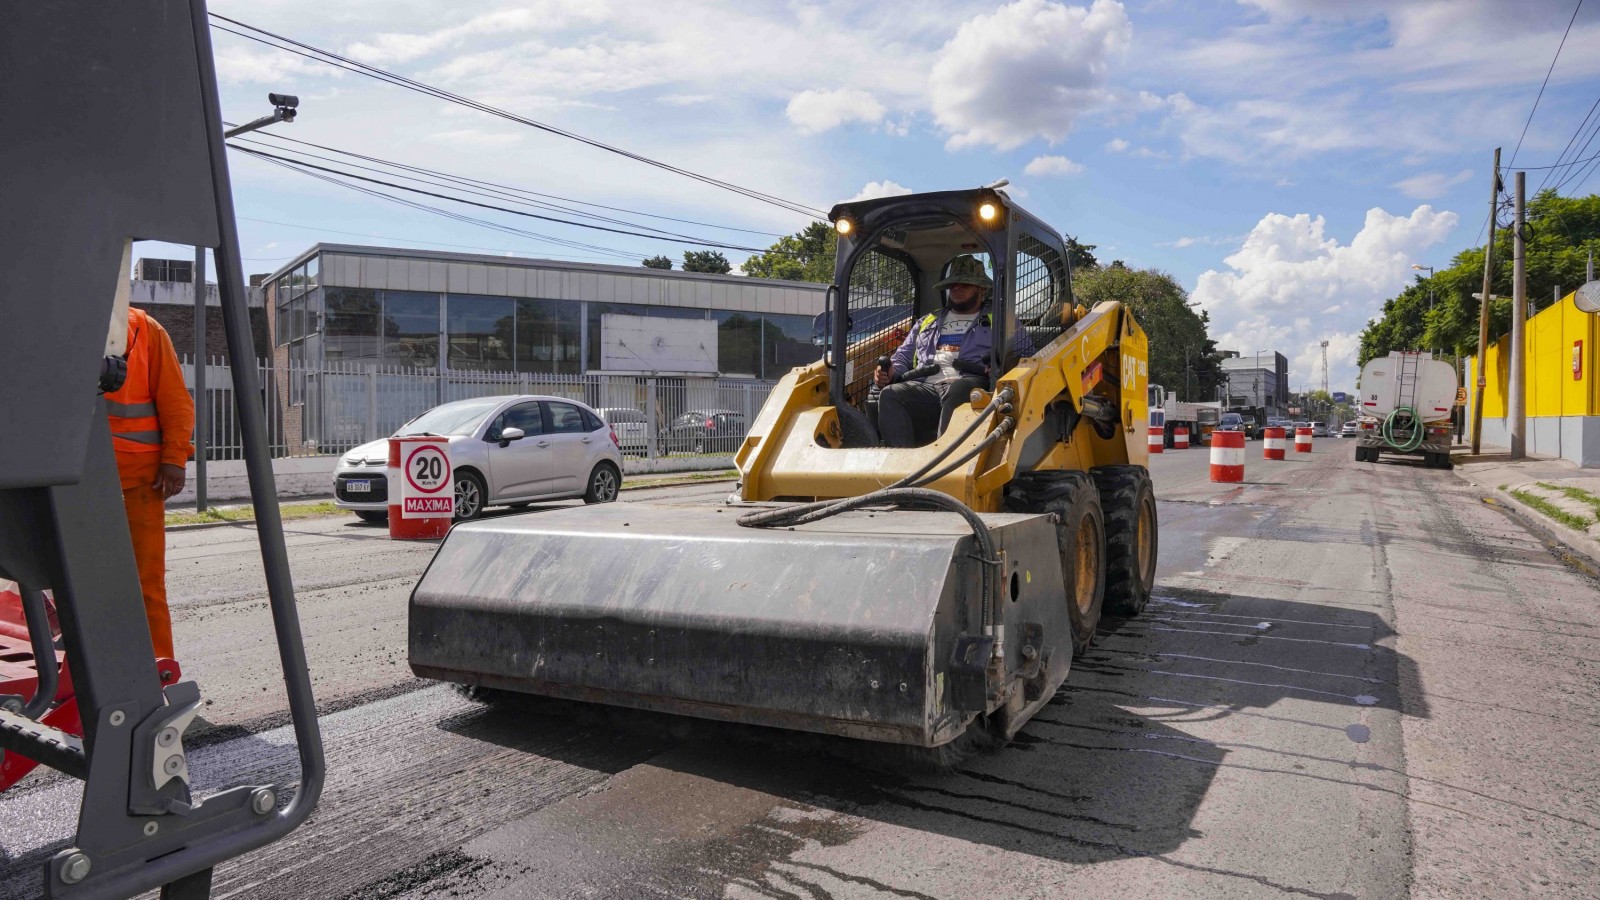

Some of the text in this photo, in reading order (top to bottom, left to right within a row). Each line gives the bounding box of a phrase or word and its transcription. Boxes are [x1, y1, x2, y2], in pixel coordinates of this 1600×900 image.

[1123, 353, 1136, 391] CAT
[416, 456, 442, 480] 20
[407, 499, 451, 511] MAXIMA
